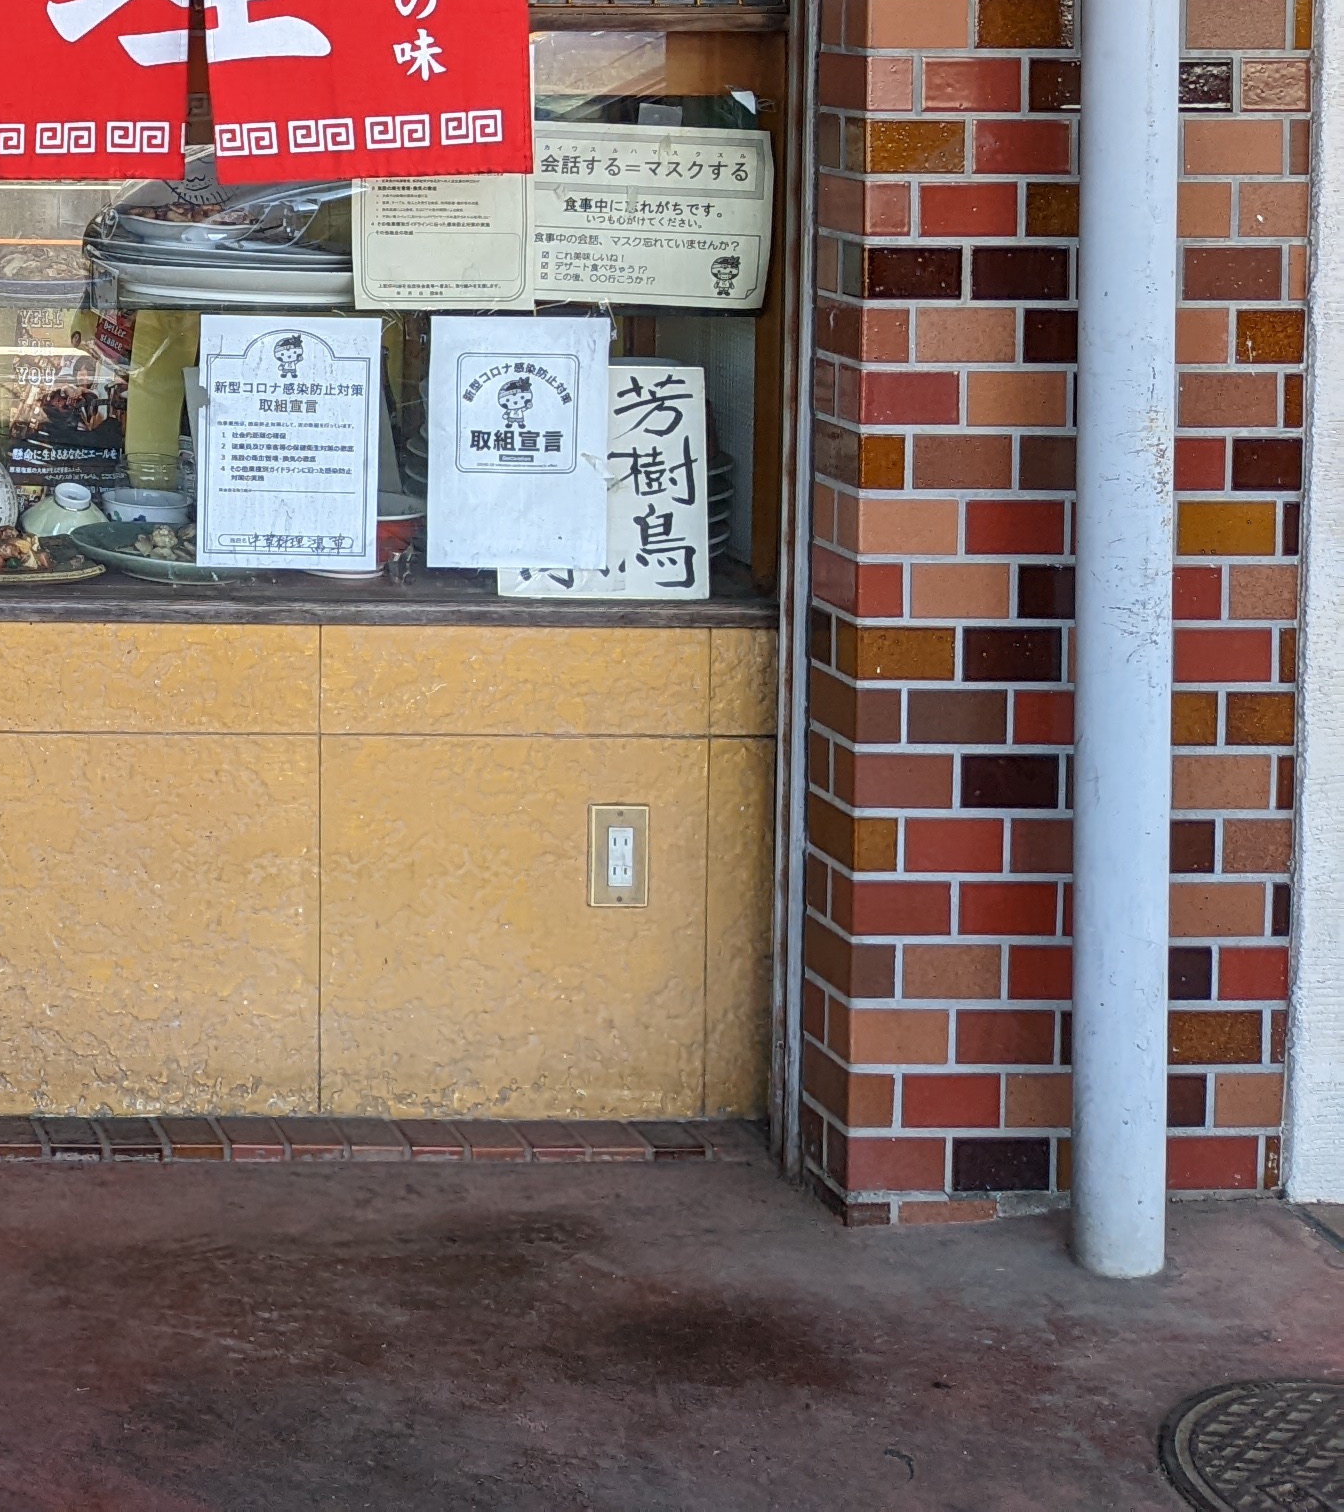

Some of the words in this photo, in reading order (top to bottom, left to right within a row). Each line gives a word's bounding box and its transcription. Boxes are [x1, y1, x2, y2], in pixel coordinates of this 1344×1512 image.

[586, 215, 703, 229] いつも心がけてください。
[214, 380, 364, 397] 新型コロナ感染防止対策
[258, 399, 319, 414] 取組宣言
[469, 430, 564, 453] 取組宣言
